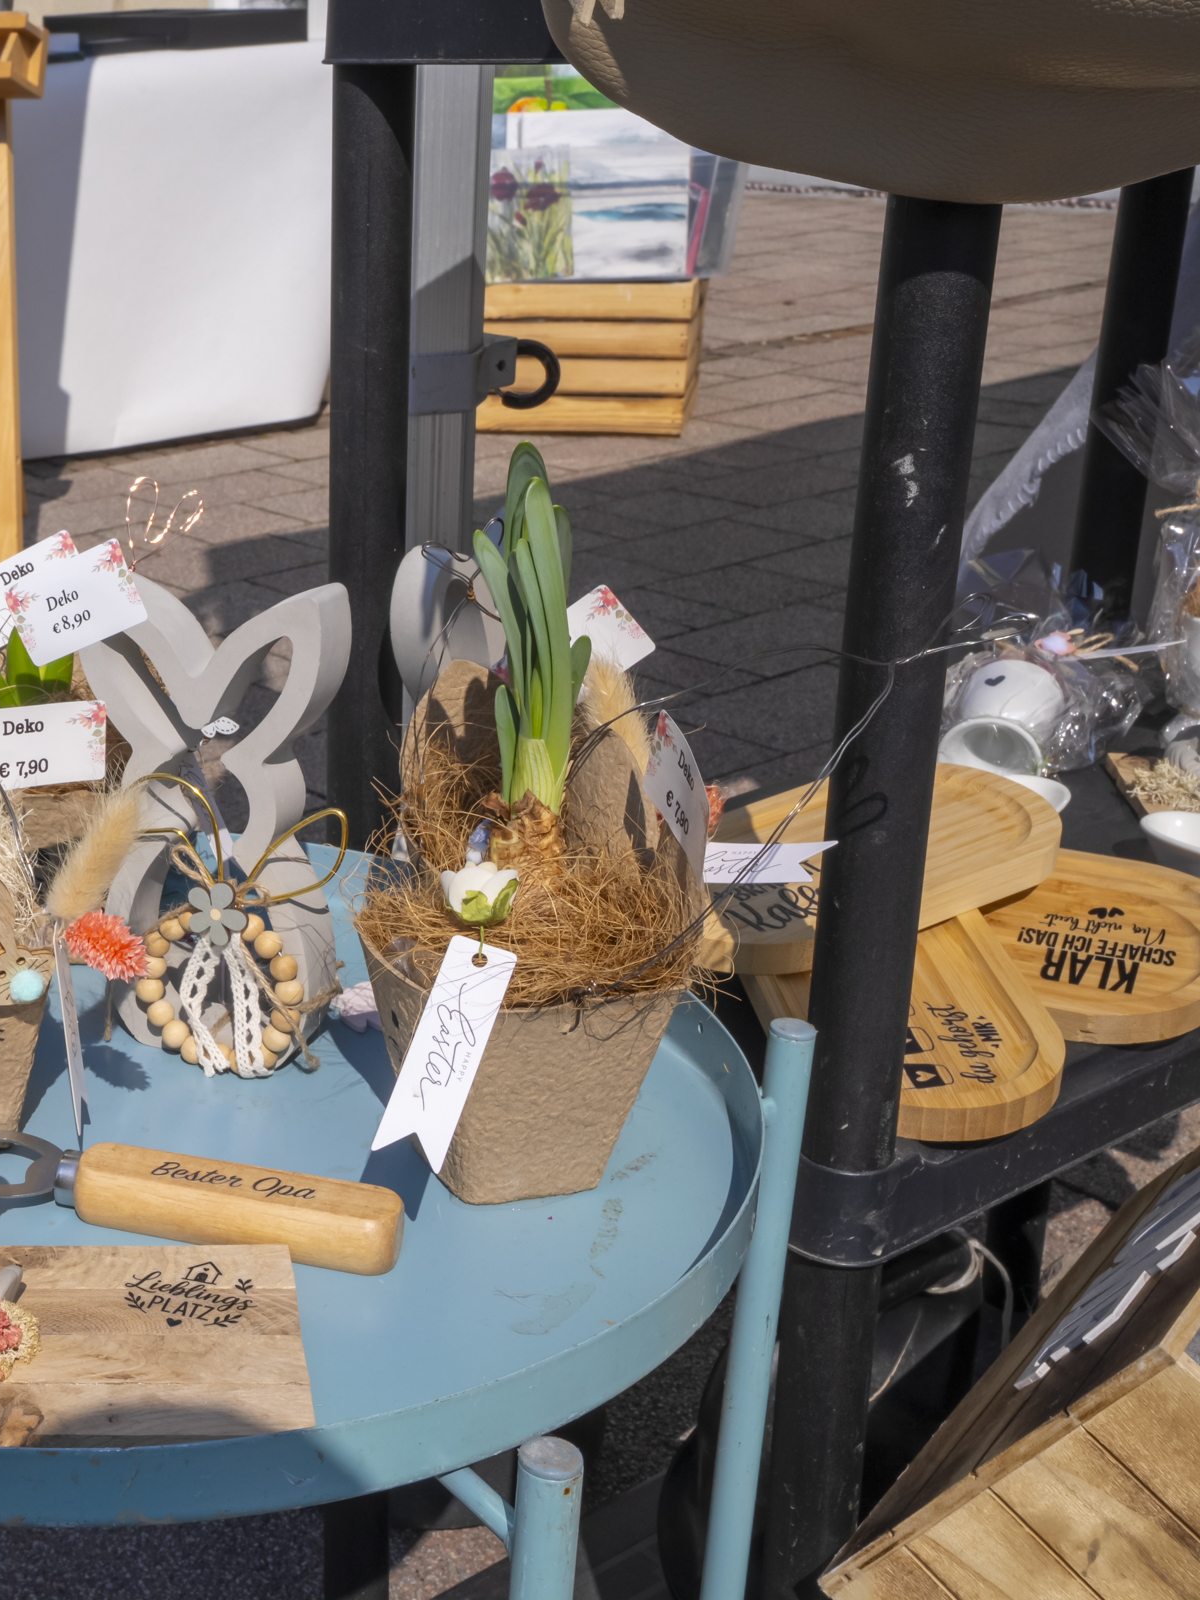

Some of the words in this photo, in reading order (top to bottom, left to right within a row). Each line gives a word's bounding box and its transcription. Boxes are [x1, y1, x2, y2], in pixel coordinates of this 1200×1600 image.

[0, 562, 35, 586] Deko
[45, 589, 79, 612] Deko
[60, 609, 91, 631] 8,90
[2, 719, 44, 736] Deko
[16, 758, 49, 779] 7,90
[678, 750, 695, 791] Deko
[666, 790, 674, 808] €
[1038, 913, 1081, 932] heute
[1076, 919, 1123, 935] nicht
[1017, 926, 1061, 949] DAS!
[1061, 934, 1094, 955] ICH
[1094, 939, 1177, 967] SCHAFFE
[1040, 947, 1140, 995] KLAR
[419, 983, 476, 1112] Easter
[456, 1051, 472, 1083] HAPPY
[960, 1061, 997, 1084] du
[150, 1161, 243, 1188] Bester
[252, 1177, 316, 1200] Opa
[124, 1271, 258, 1312] Lieblings
[147, 1295, 215, 1322] PLATZ
